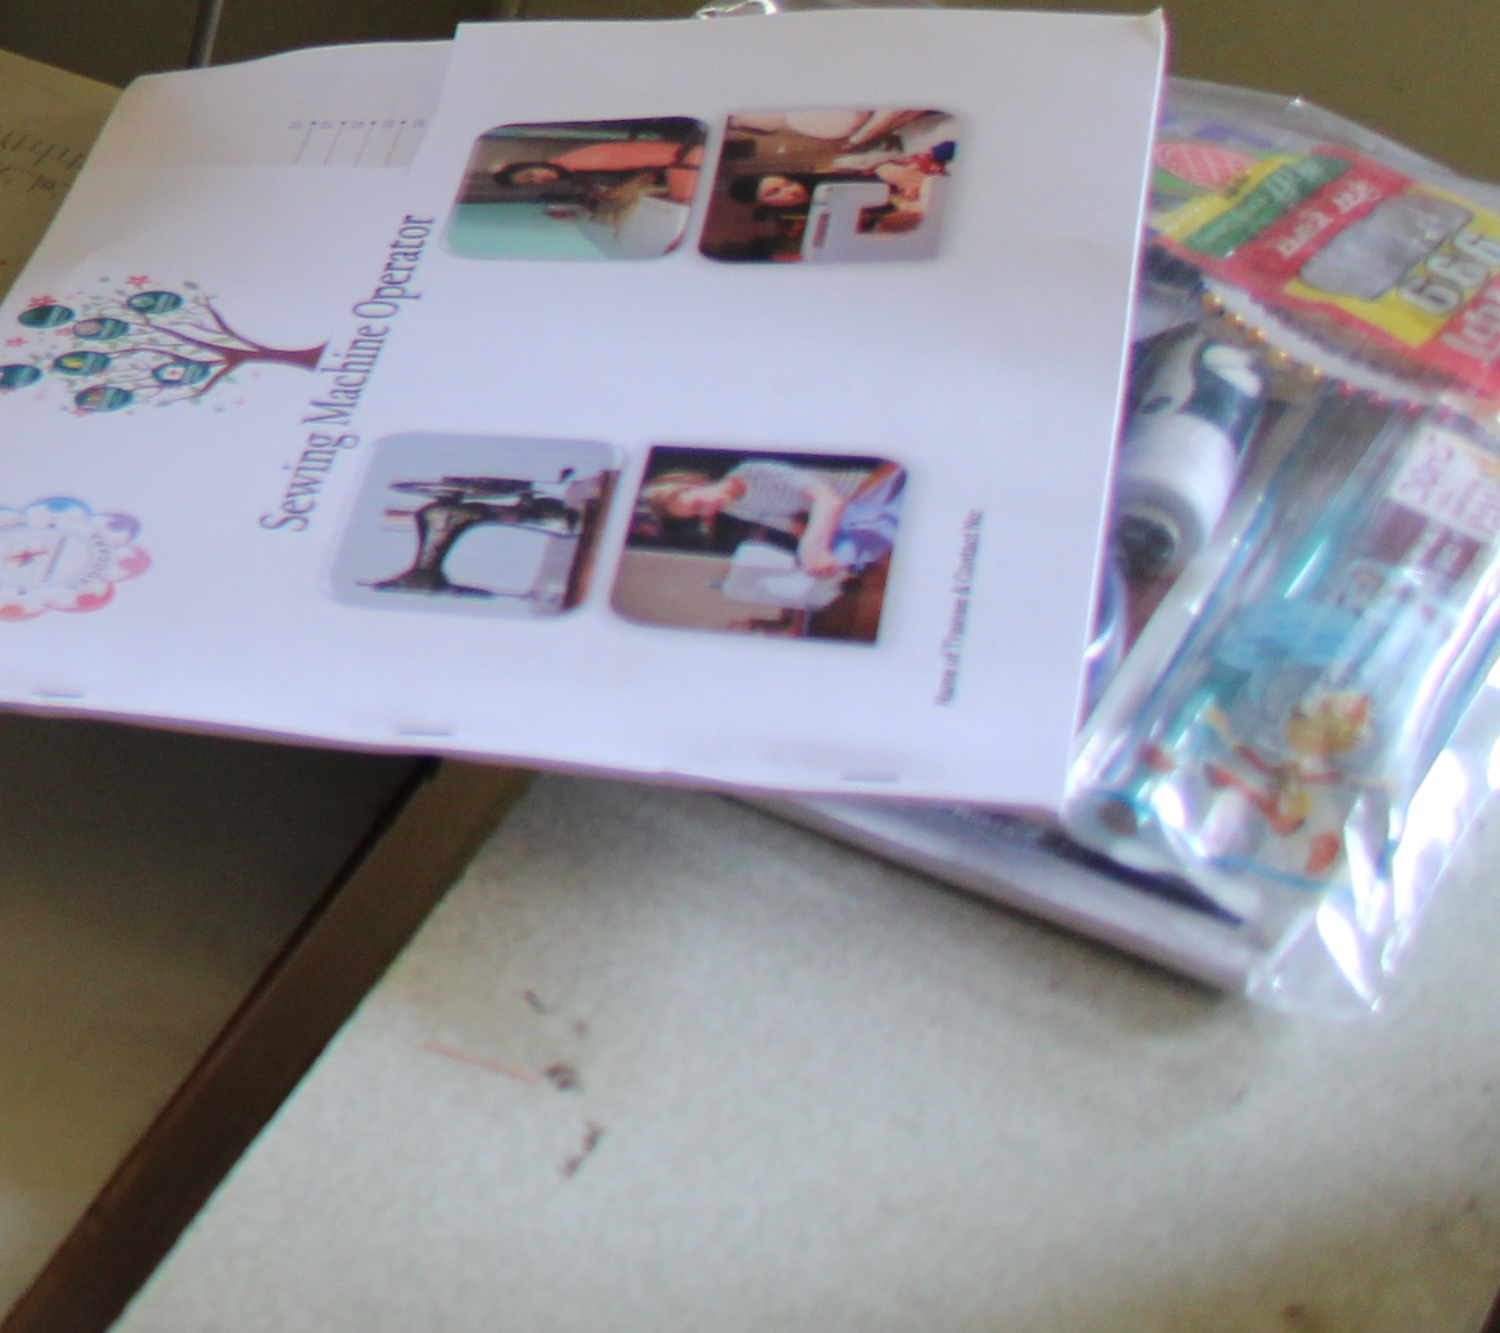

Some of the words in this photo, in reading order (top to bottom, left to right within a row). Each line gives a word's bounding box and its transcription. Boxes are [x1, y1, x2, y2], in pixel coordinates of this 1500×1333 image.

[352, 214, 435, 319] Operator
[301, 325, 391, 426] Machine
[259, 432, 360, 532] Sewing
